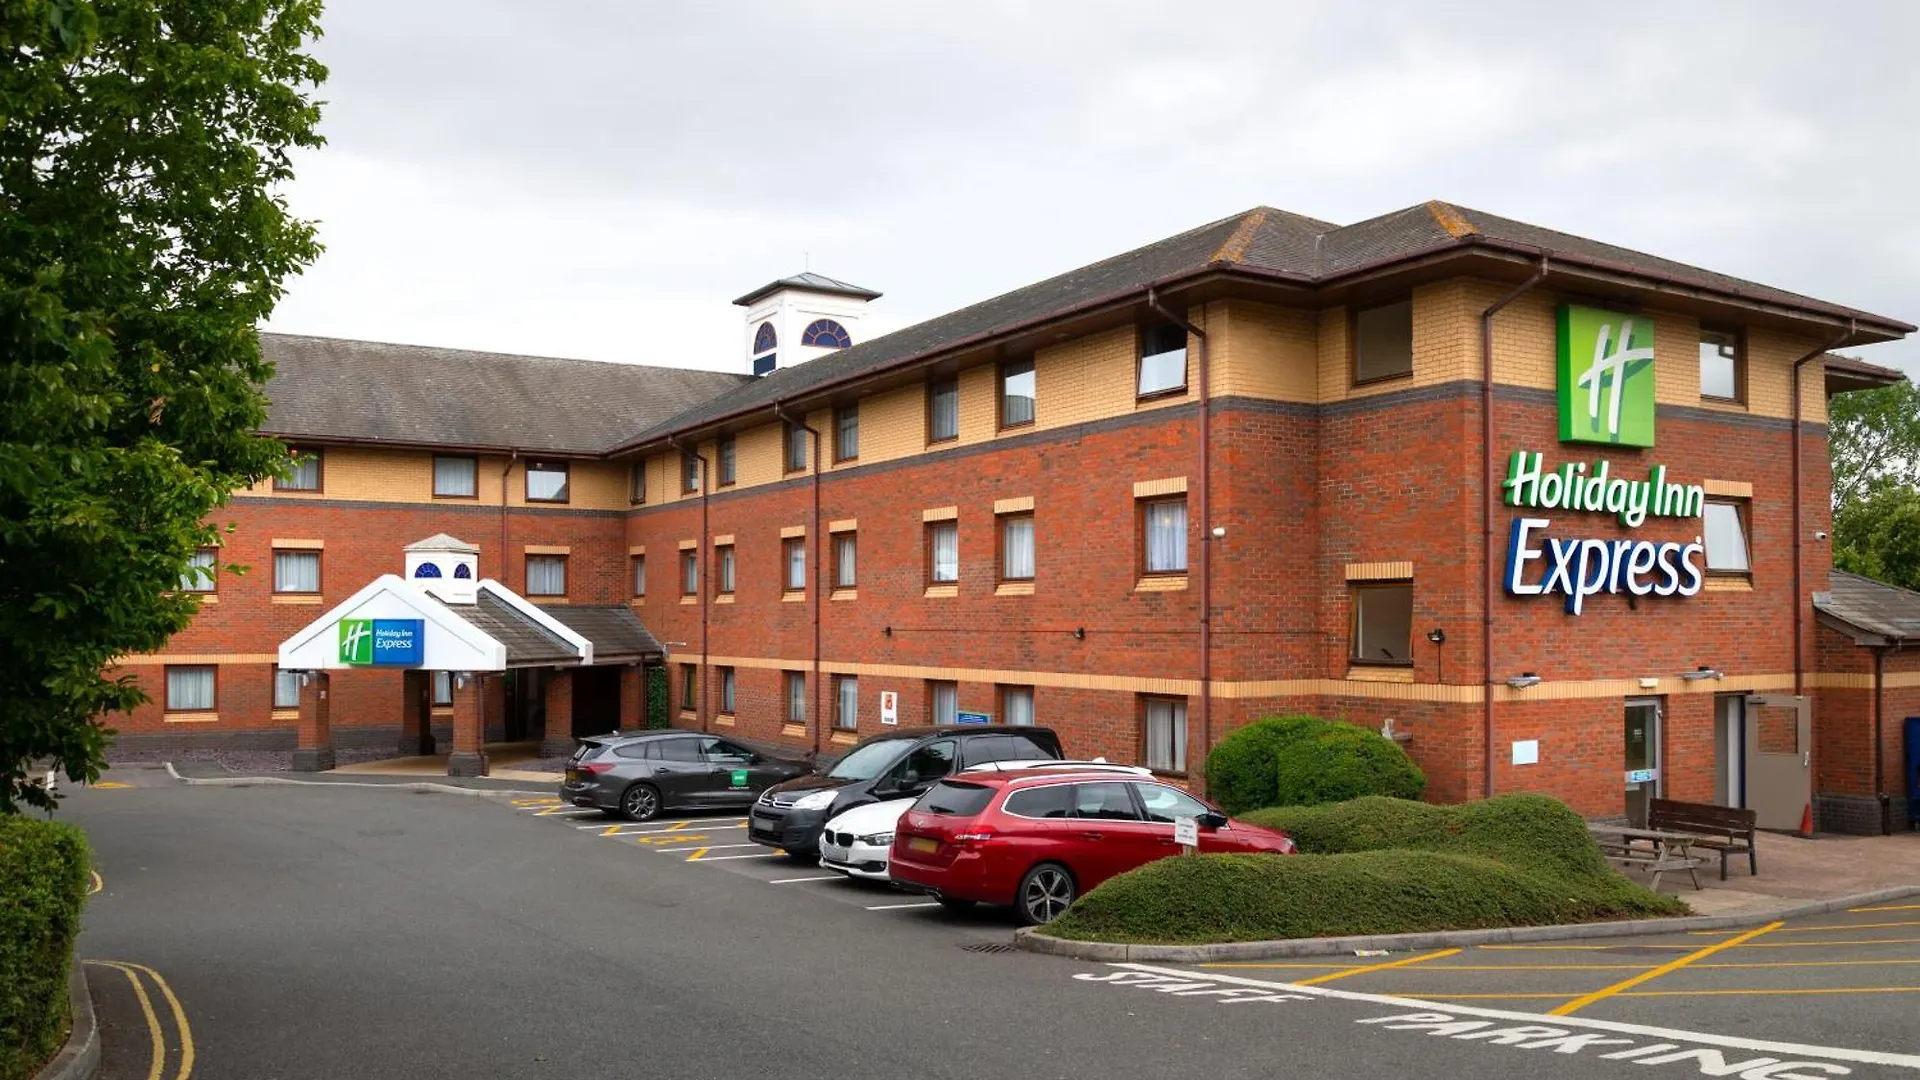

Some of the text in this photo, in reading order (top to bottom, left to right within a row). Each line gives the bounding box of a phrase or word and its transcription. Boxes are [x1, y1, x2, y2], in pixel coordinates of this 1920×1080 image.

[1504, 451, 1704, 527] Holiday Inn
[1506, 517, 1704, 616] Express
[375, 629, 413, 639] Holiday Inn
[375, 638, 412, 650] Express
[1072, 972, 1316, 1004] STAFF
[1355, 1014, 1852, 1080] PARKING
